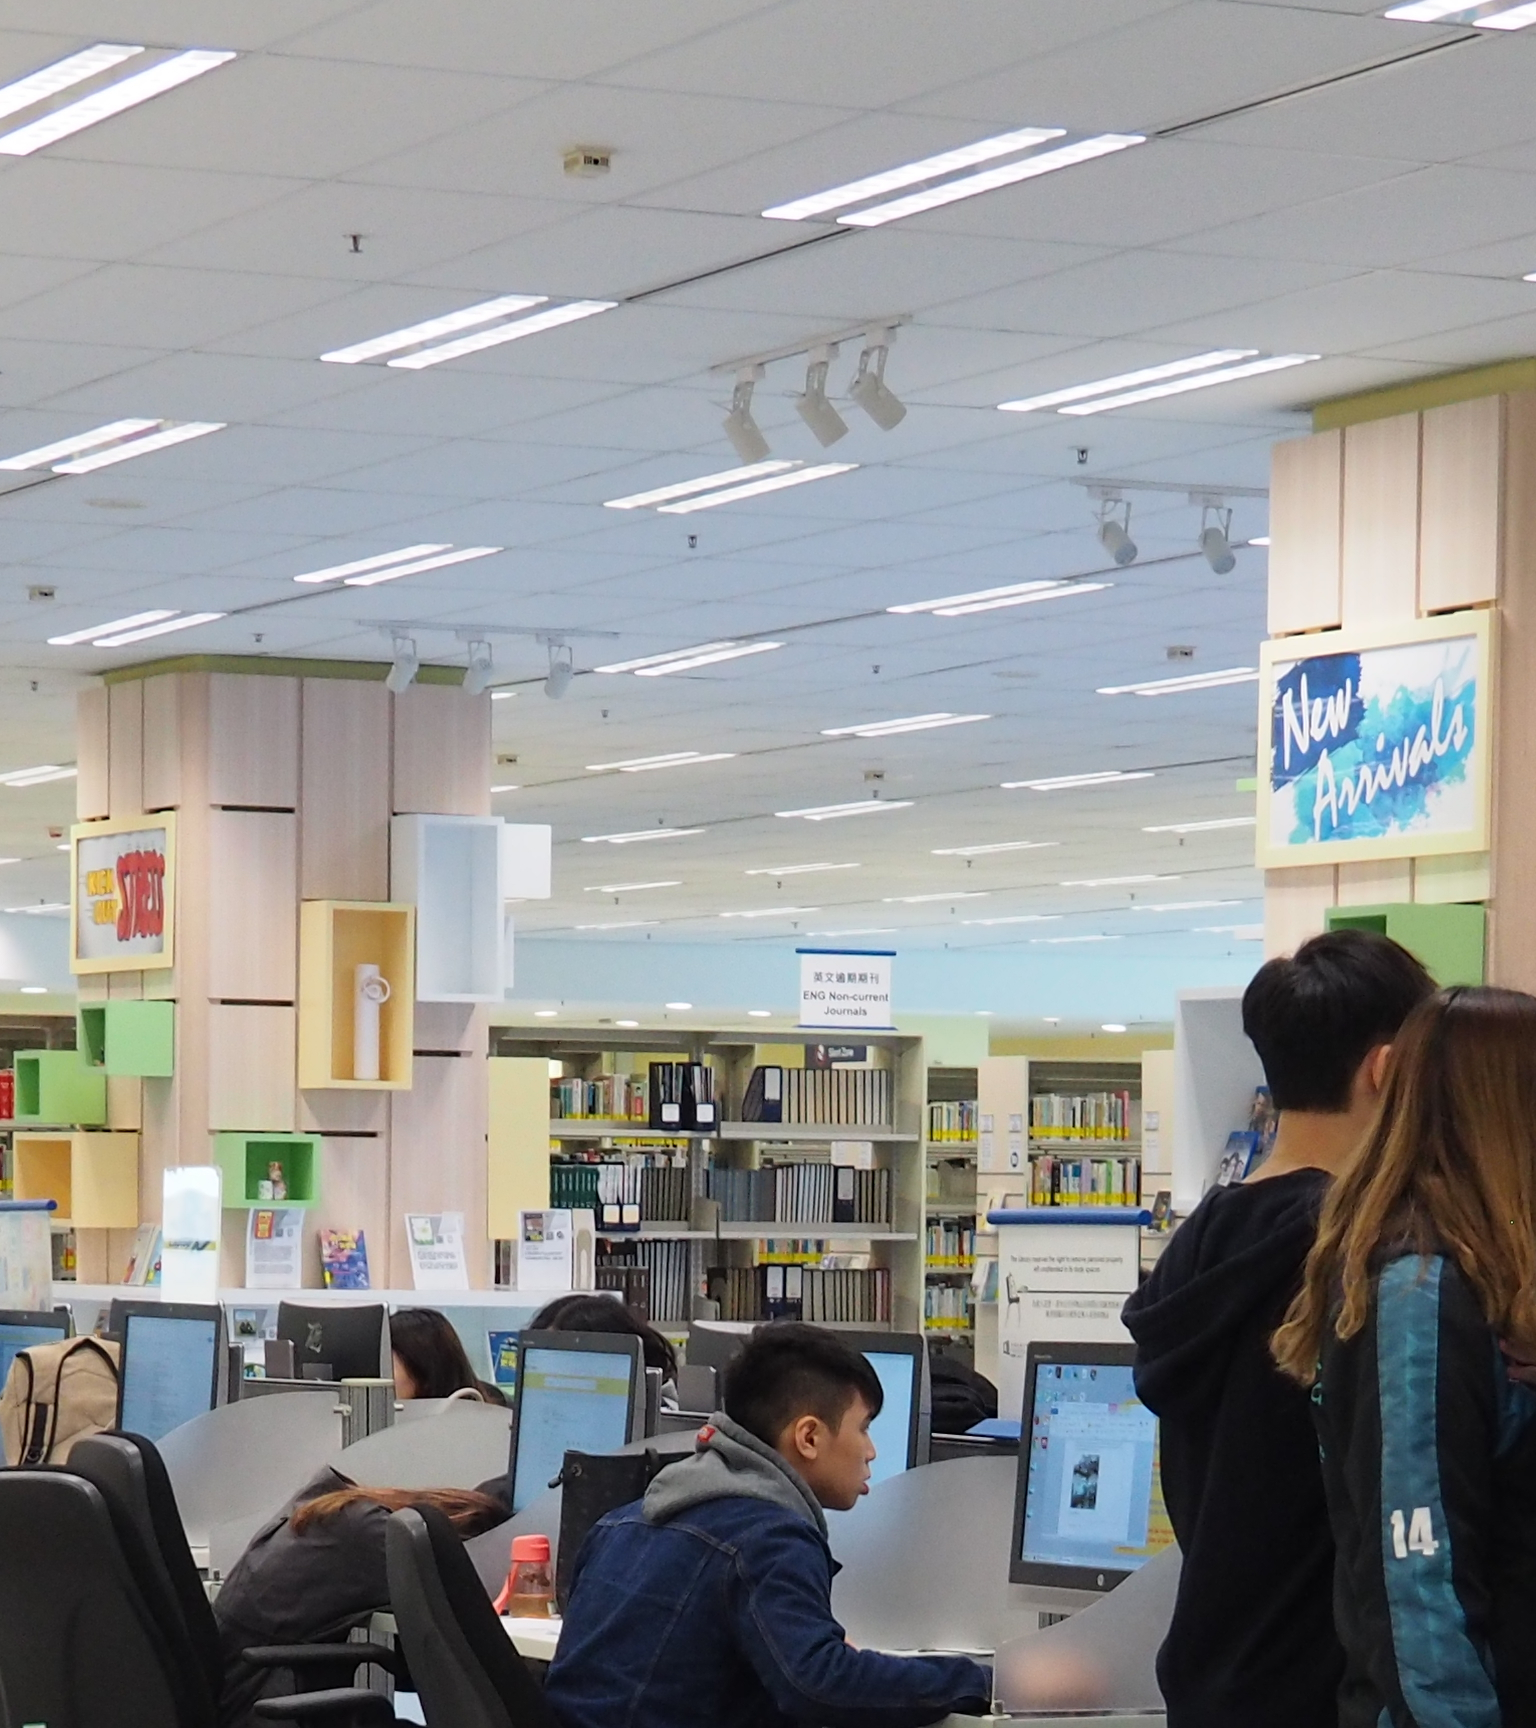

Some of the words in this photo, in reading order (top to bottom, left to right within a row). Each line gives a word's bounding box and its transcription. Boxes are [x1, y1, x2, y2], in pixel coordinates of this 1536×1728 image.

[1283, 673, 1352, 771] New
[1314, 677, 1469, 842] Arrivals
[803, 990, 826, 1001] ENG
[828, 991, 889, 1002] Non-current
[823, 1006, 868, 1017] Journals
[1390, 1506, 1439, 1559] 14
